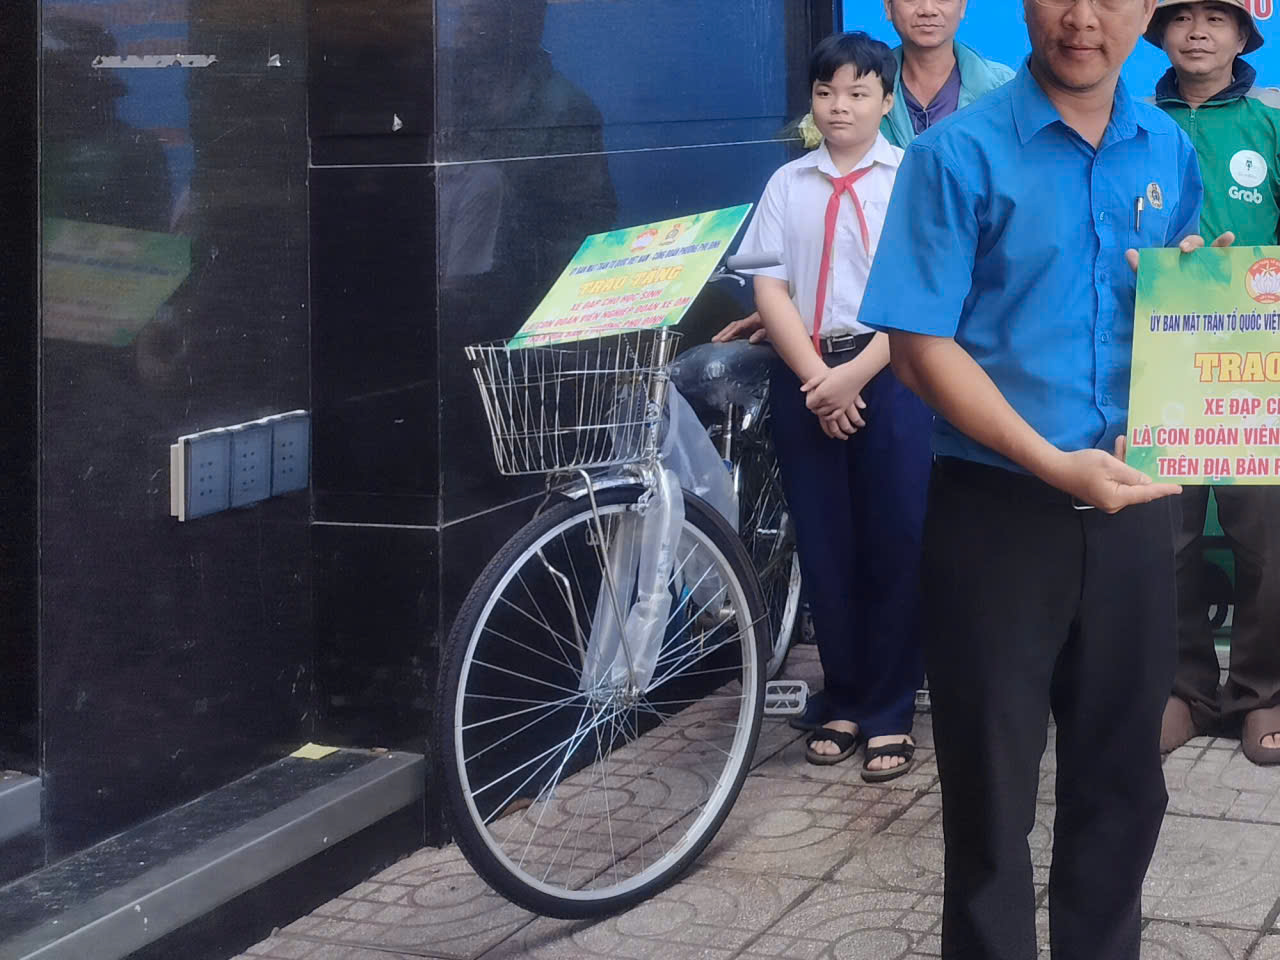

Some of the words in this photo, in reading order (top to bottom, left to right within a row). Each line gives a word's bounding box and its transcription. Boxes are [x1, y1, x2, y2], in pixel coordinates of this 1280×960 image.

[1228, 186, 1263, 205] Grab
[1150, 310, 1161, 332] ỦY
[1163, 314, 1180, 332] BAN
[1203, 312, 1224, 335] TRẬN
[1227, 307, 1238, 331] TỔ
[1239, 308, 1261, 332] QUỐC
[1264, 310, 1280, 334] VIỆT
[1204, 398, 1224, 415] XE
[1229, 398, 1261, 418] ĐẠP
[1132, 426, 1152, 446] LÀ
[1156, 428, 1189, 445] CON
[1194, 425, 1238, 445] ĐOÀN
[1243, 425, 1280, 445] VIÊN
[1158, 455, 1199, 475] TRÊN
[1203, 458, 1231, 480] ĐỊA
[1236, 455, 1269, 475] BÀN
